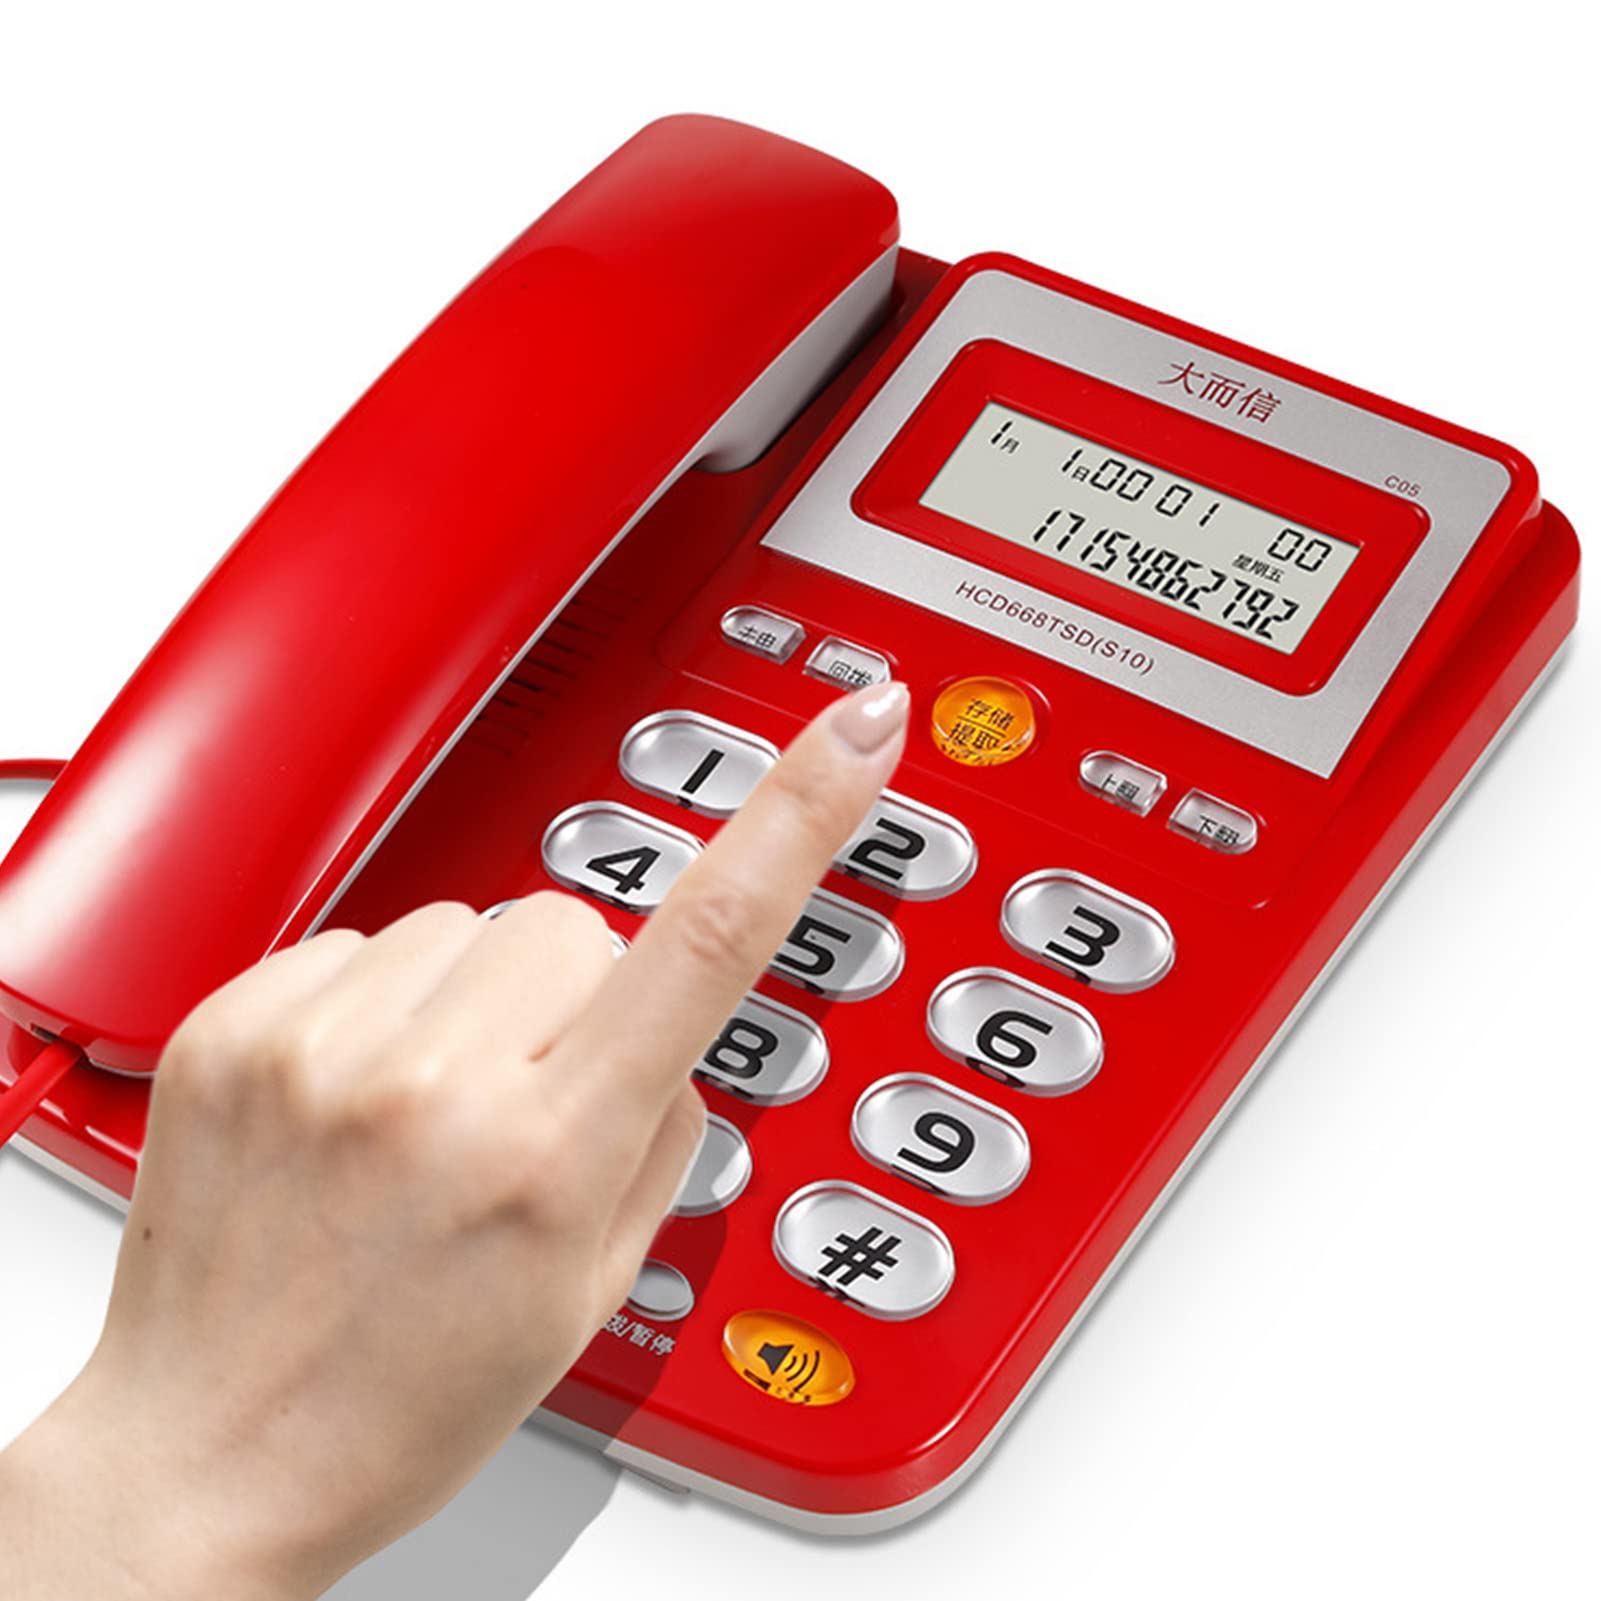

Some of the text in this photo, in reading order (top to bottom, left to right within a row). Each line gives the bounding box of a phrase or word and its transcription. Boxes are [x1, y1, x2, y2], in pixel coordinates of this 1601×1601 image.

[1157, 362, 1281, 423] 大而信
[1383, 474, 1420, 498] C05
[1232, 555, 1284, 583] 星期五
[1267, 528, 1332, 572] 00
[955, 581, 1154, 676] HCD668TSD(S10)
[682, 750, 724, 794] 1
[586, 846, 661, 894] 4
[848, 818, 925, 881] 2
[774, 914, 852, 976] 5
[1046, 905, 1120, 969] 3
[703, 1017, 778, 1080] 8
[975, 1011, 1053, 1069] 6
[897, 1112, 975, 1173] 9
[818, 1226, 902, 1286] #
